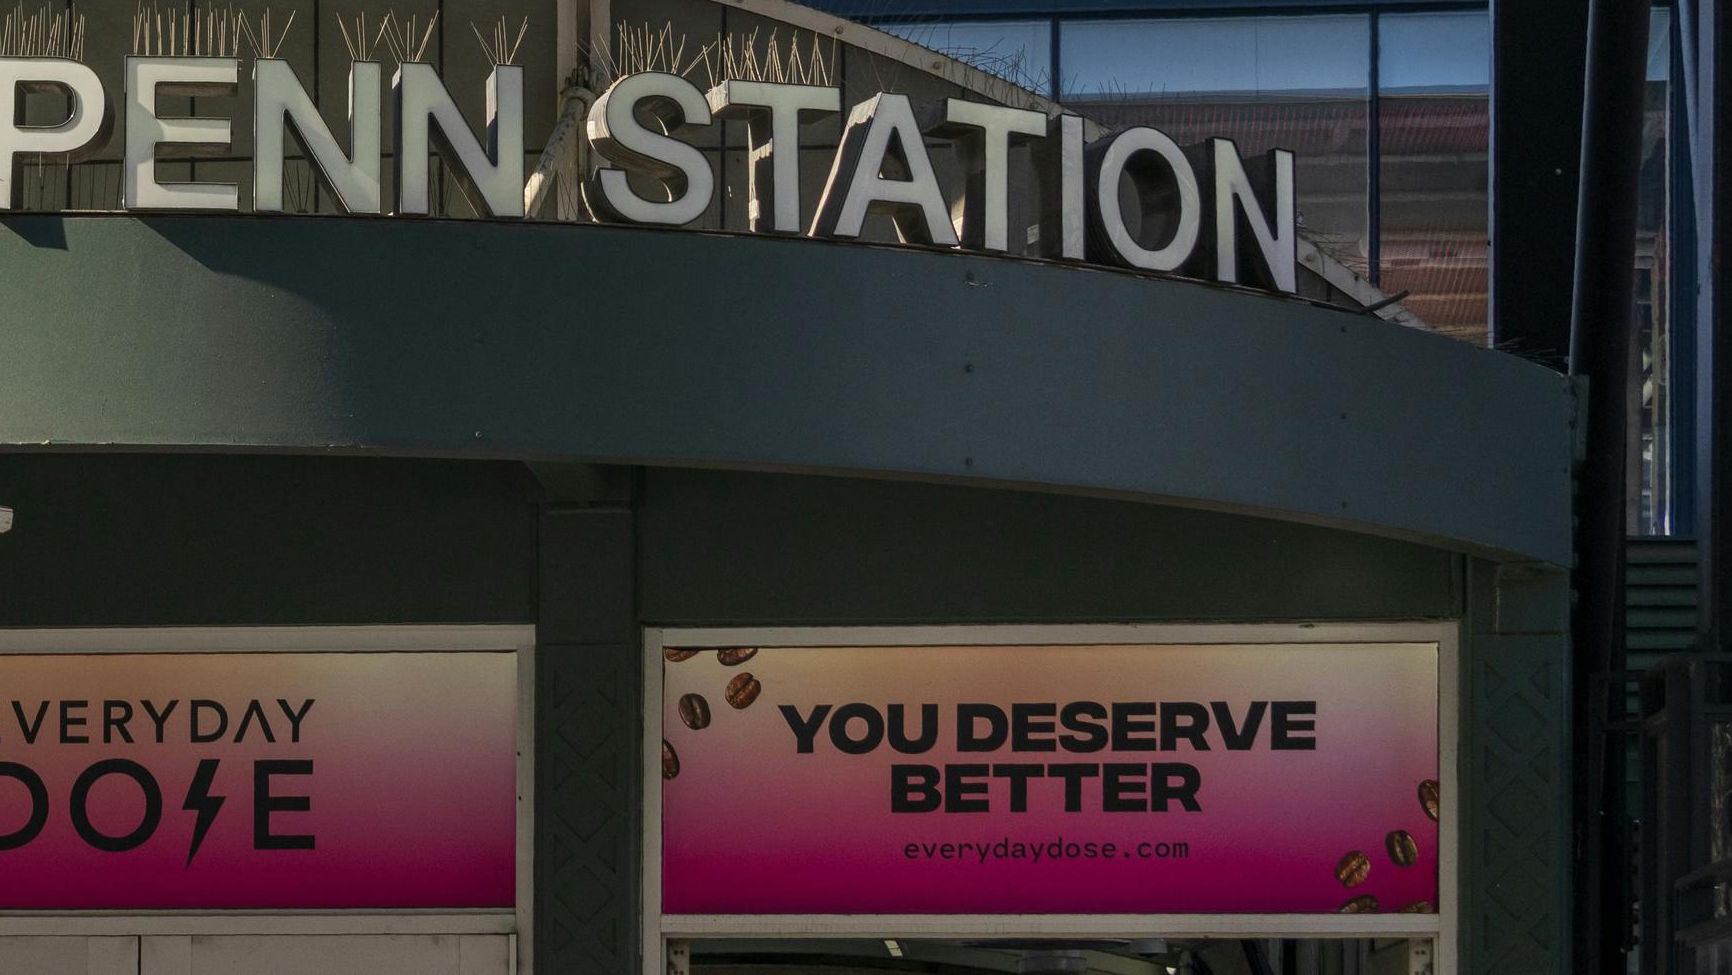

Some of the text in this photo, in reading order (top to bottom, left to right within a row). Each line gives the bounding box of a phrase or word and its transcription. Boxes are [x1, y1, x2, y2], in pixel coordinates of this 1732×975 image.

[584, 71, 1298, 294] STATION
[777, 701, 1316, 755] YOU DESERVE
[890, 762, 1202, 814] BETTER
[903, 837, 1190, 864] everydaydose.com
